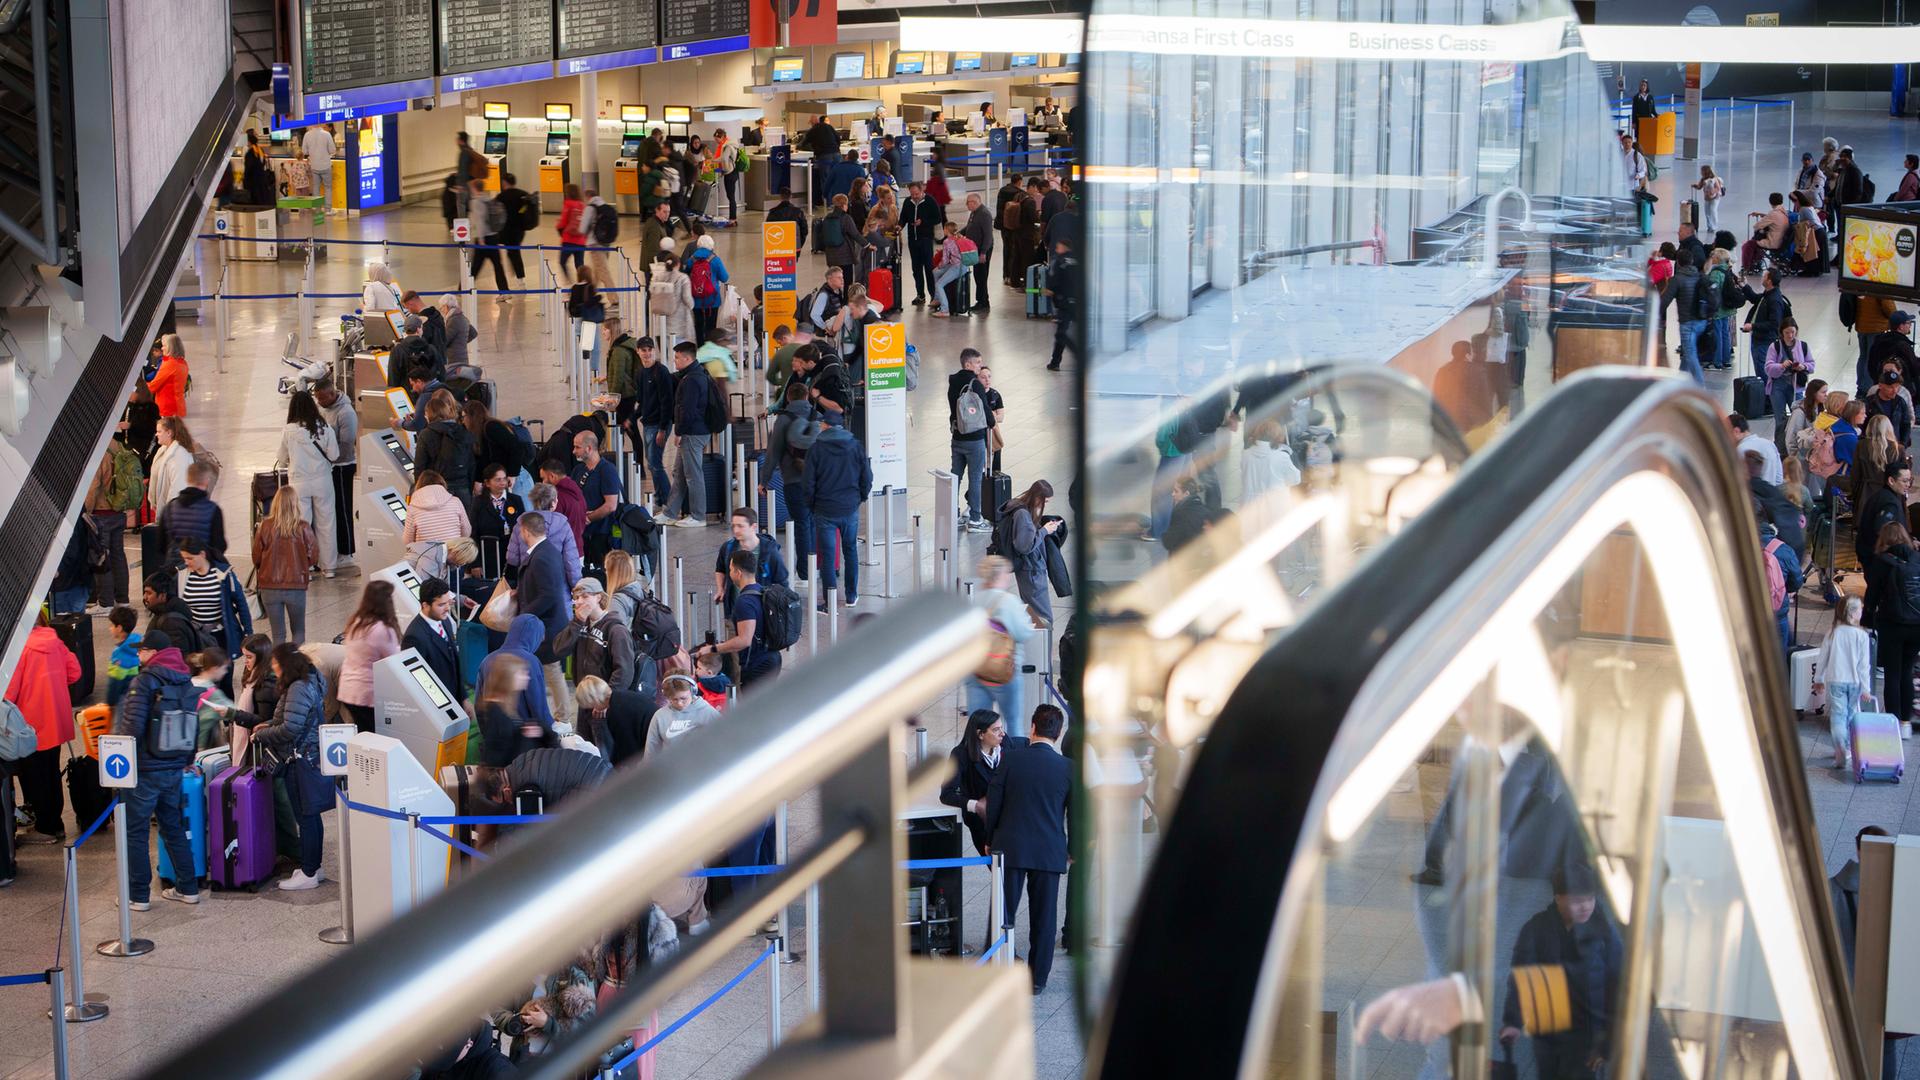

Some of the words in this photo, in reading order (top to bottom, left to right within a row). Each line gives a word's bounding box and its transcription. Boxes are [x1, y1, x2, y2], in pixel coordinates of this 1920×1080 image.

[1194, 28, 1238, 46] First
[1348, 32, 1434, 50] Business
[870, 357, 903, 365] Lufthansa
[670, 719, 692, 730] NIKE
